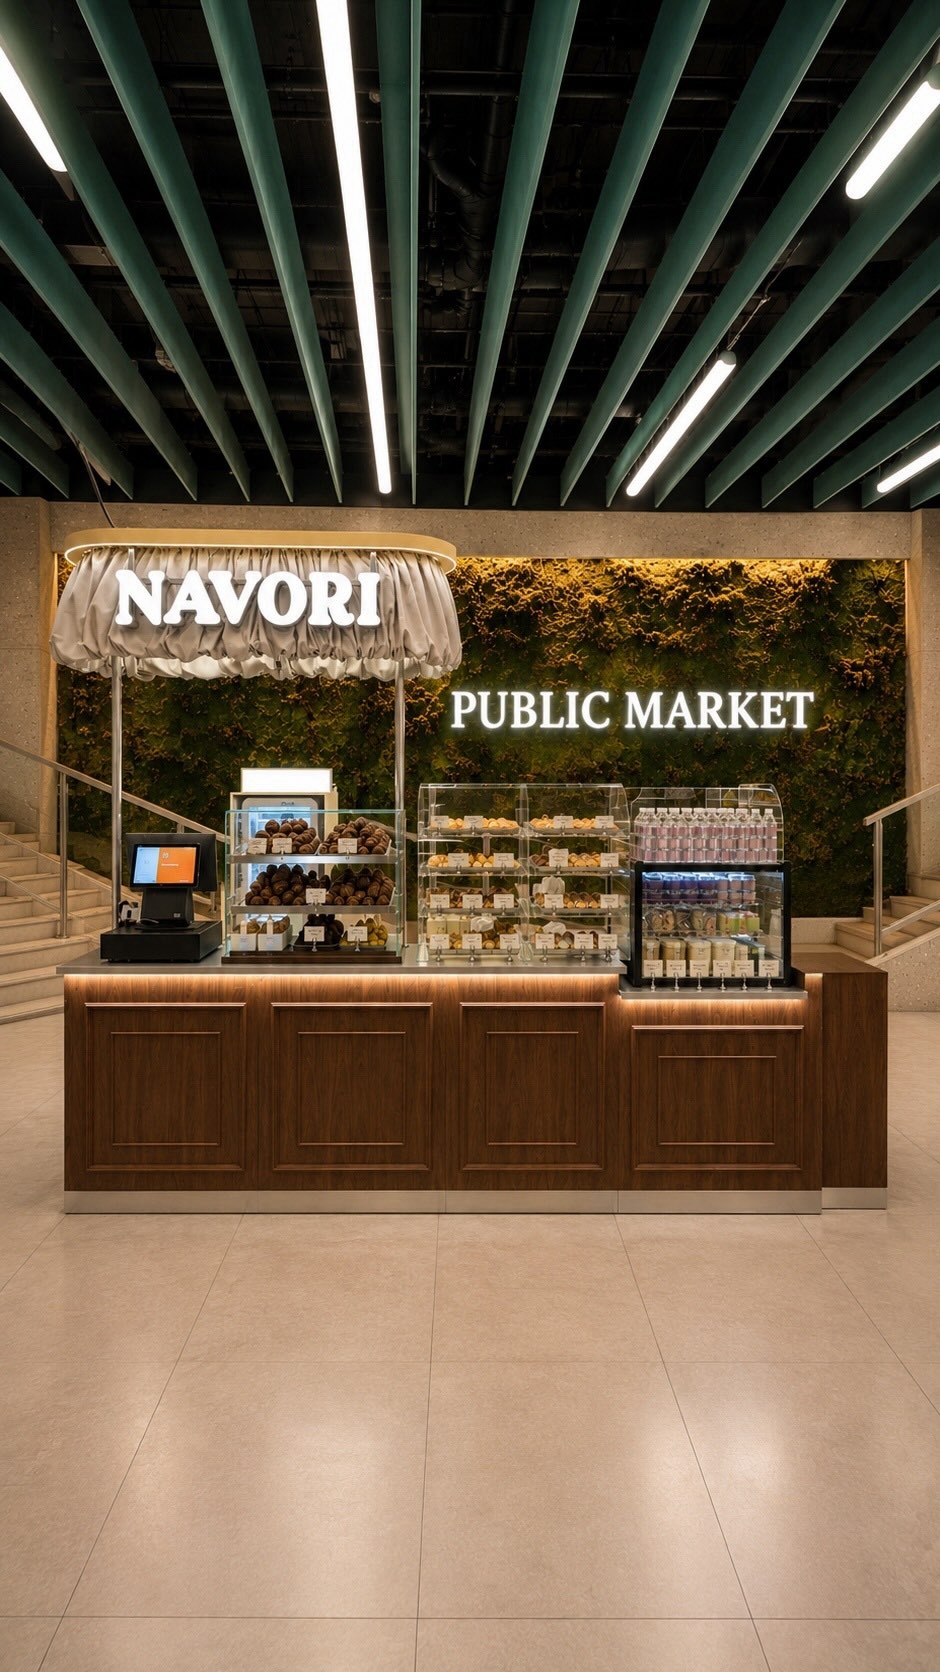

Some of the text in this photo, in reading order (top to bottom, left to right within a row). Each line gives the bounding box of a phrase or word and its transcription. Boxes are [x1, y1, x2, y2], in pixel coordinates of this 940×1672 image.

[114, 567, 381, 627] NAVORI
[452, 691, 814, 730] PUBLIC MARKET
